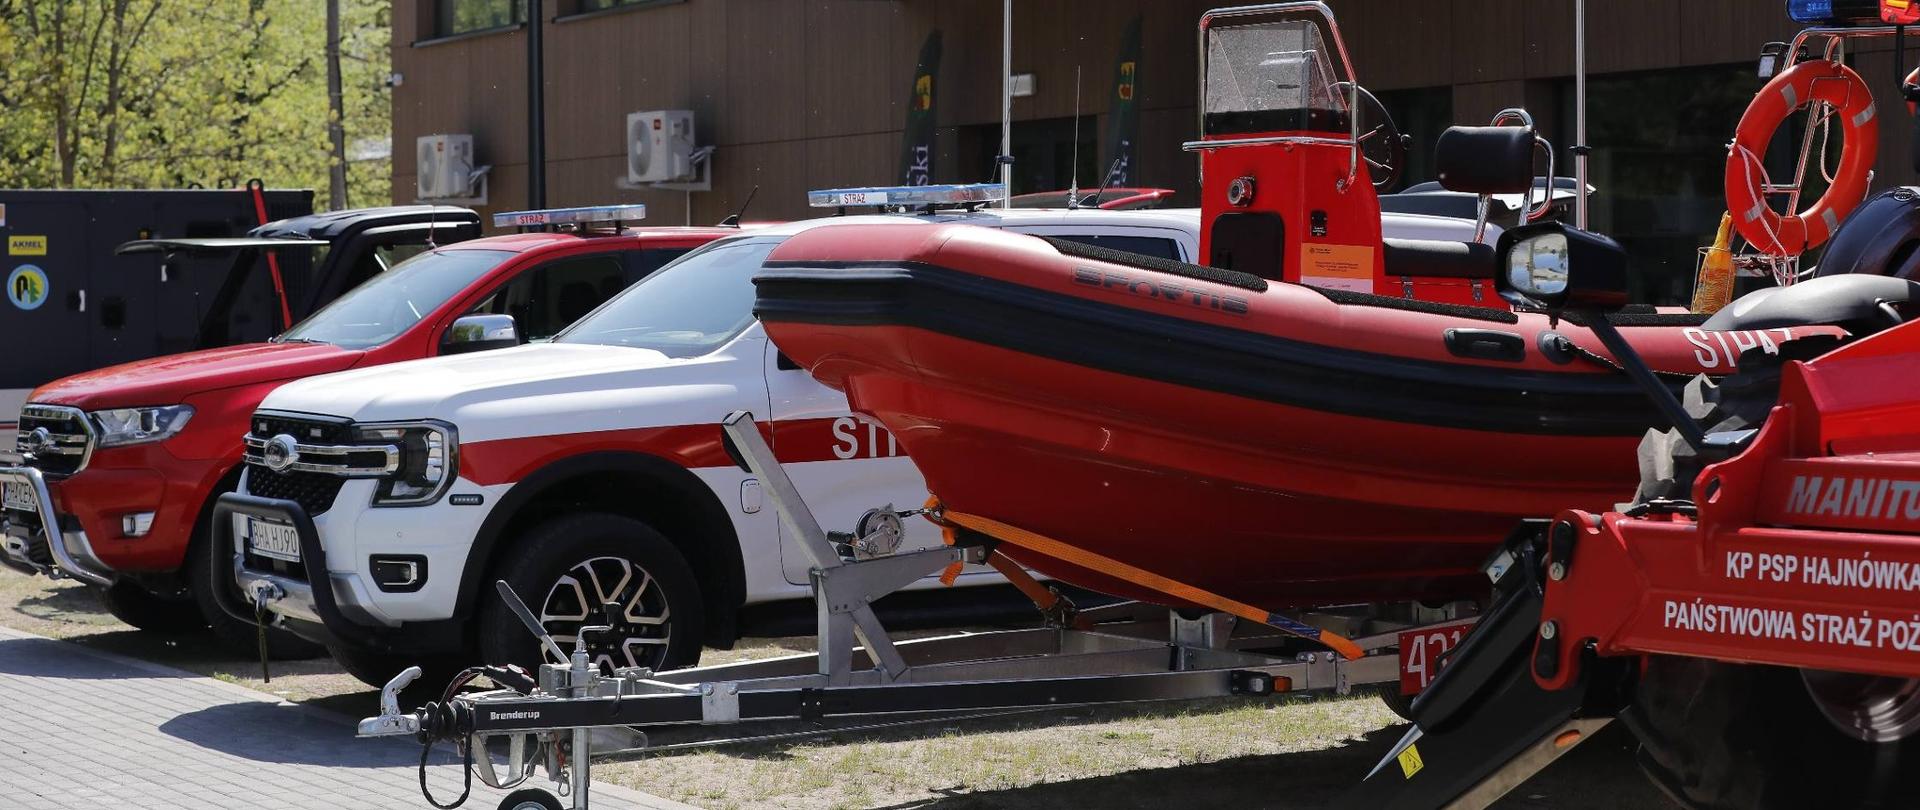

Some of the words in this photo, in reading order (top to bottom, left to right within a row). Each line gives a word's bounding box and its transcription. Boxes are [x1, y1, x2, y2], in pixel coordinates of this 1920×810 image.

[1726, 551, 1753, 579] KP
[1758, 553, 1798, 583] PSP
[1803, 552, 1920, 591] HAJNÓWKA
[1664, 597, 1797, 640] PAŃSTWOWA
[1801, 610, 1873, 647] STRAŻ
[490, 710, 540, 720] Brenderup
